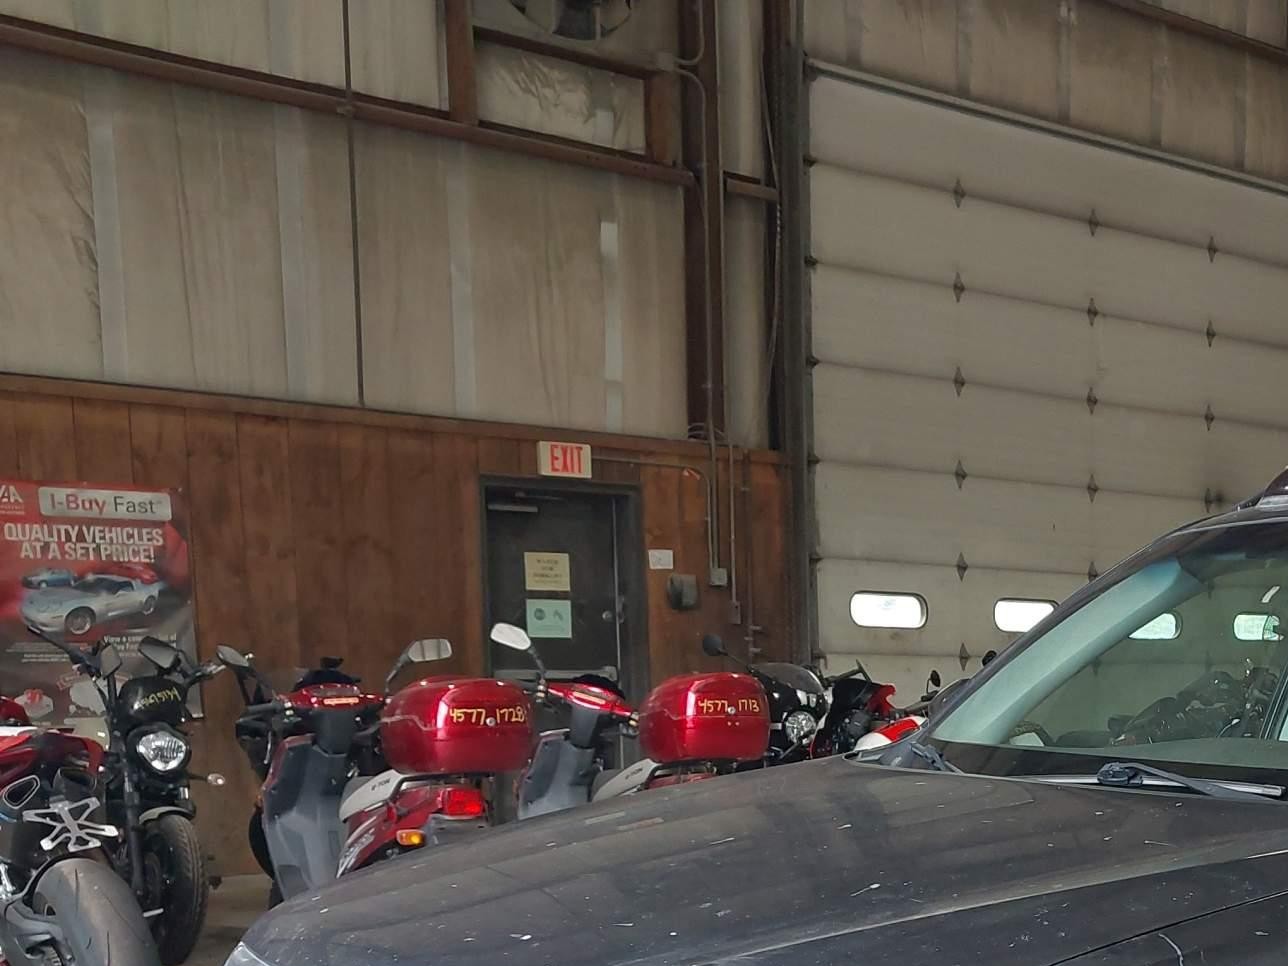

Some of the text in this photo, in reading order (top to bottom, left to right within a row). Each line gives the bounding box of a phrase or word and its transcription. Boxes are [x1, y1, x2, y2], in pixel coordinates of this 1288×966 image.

[550, 445, 582, 473] EXIT
[50, 493, 156, 516] I-Buy Fast
[4, 522, 164, 546] QUALITY VEHICLES
[20, 542, 155, 563] AT A SET PRICE!
[450, 706, 525, 726] 4577 1728
[698, 699, 760, 714] 4577 1713
